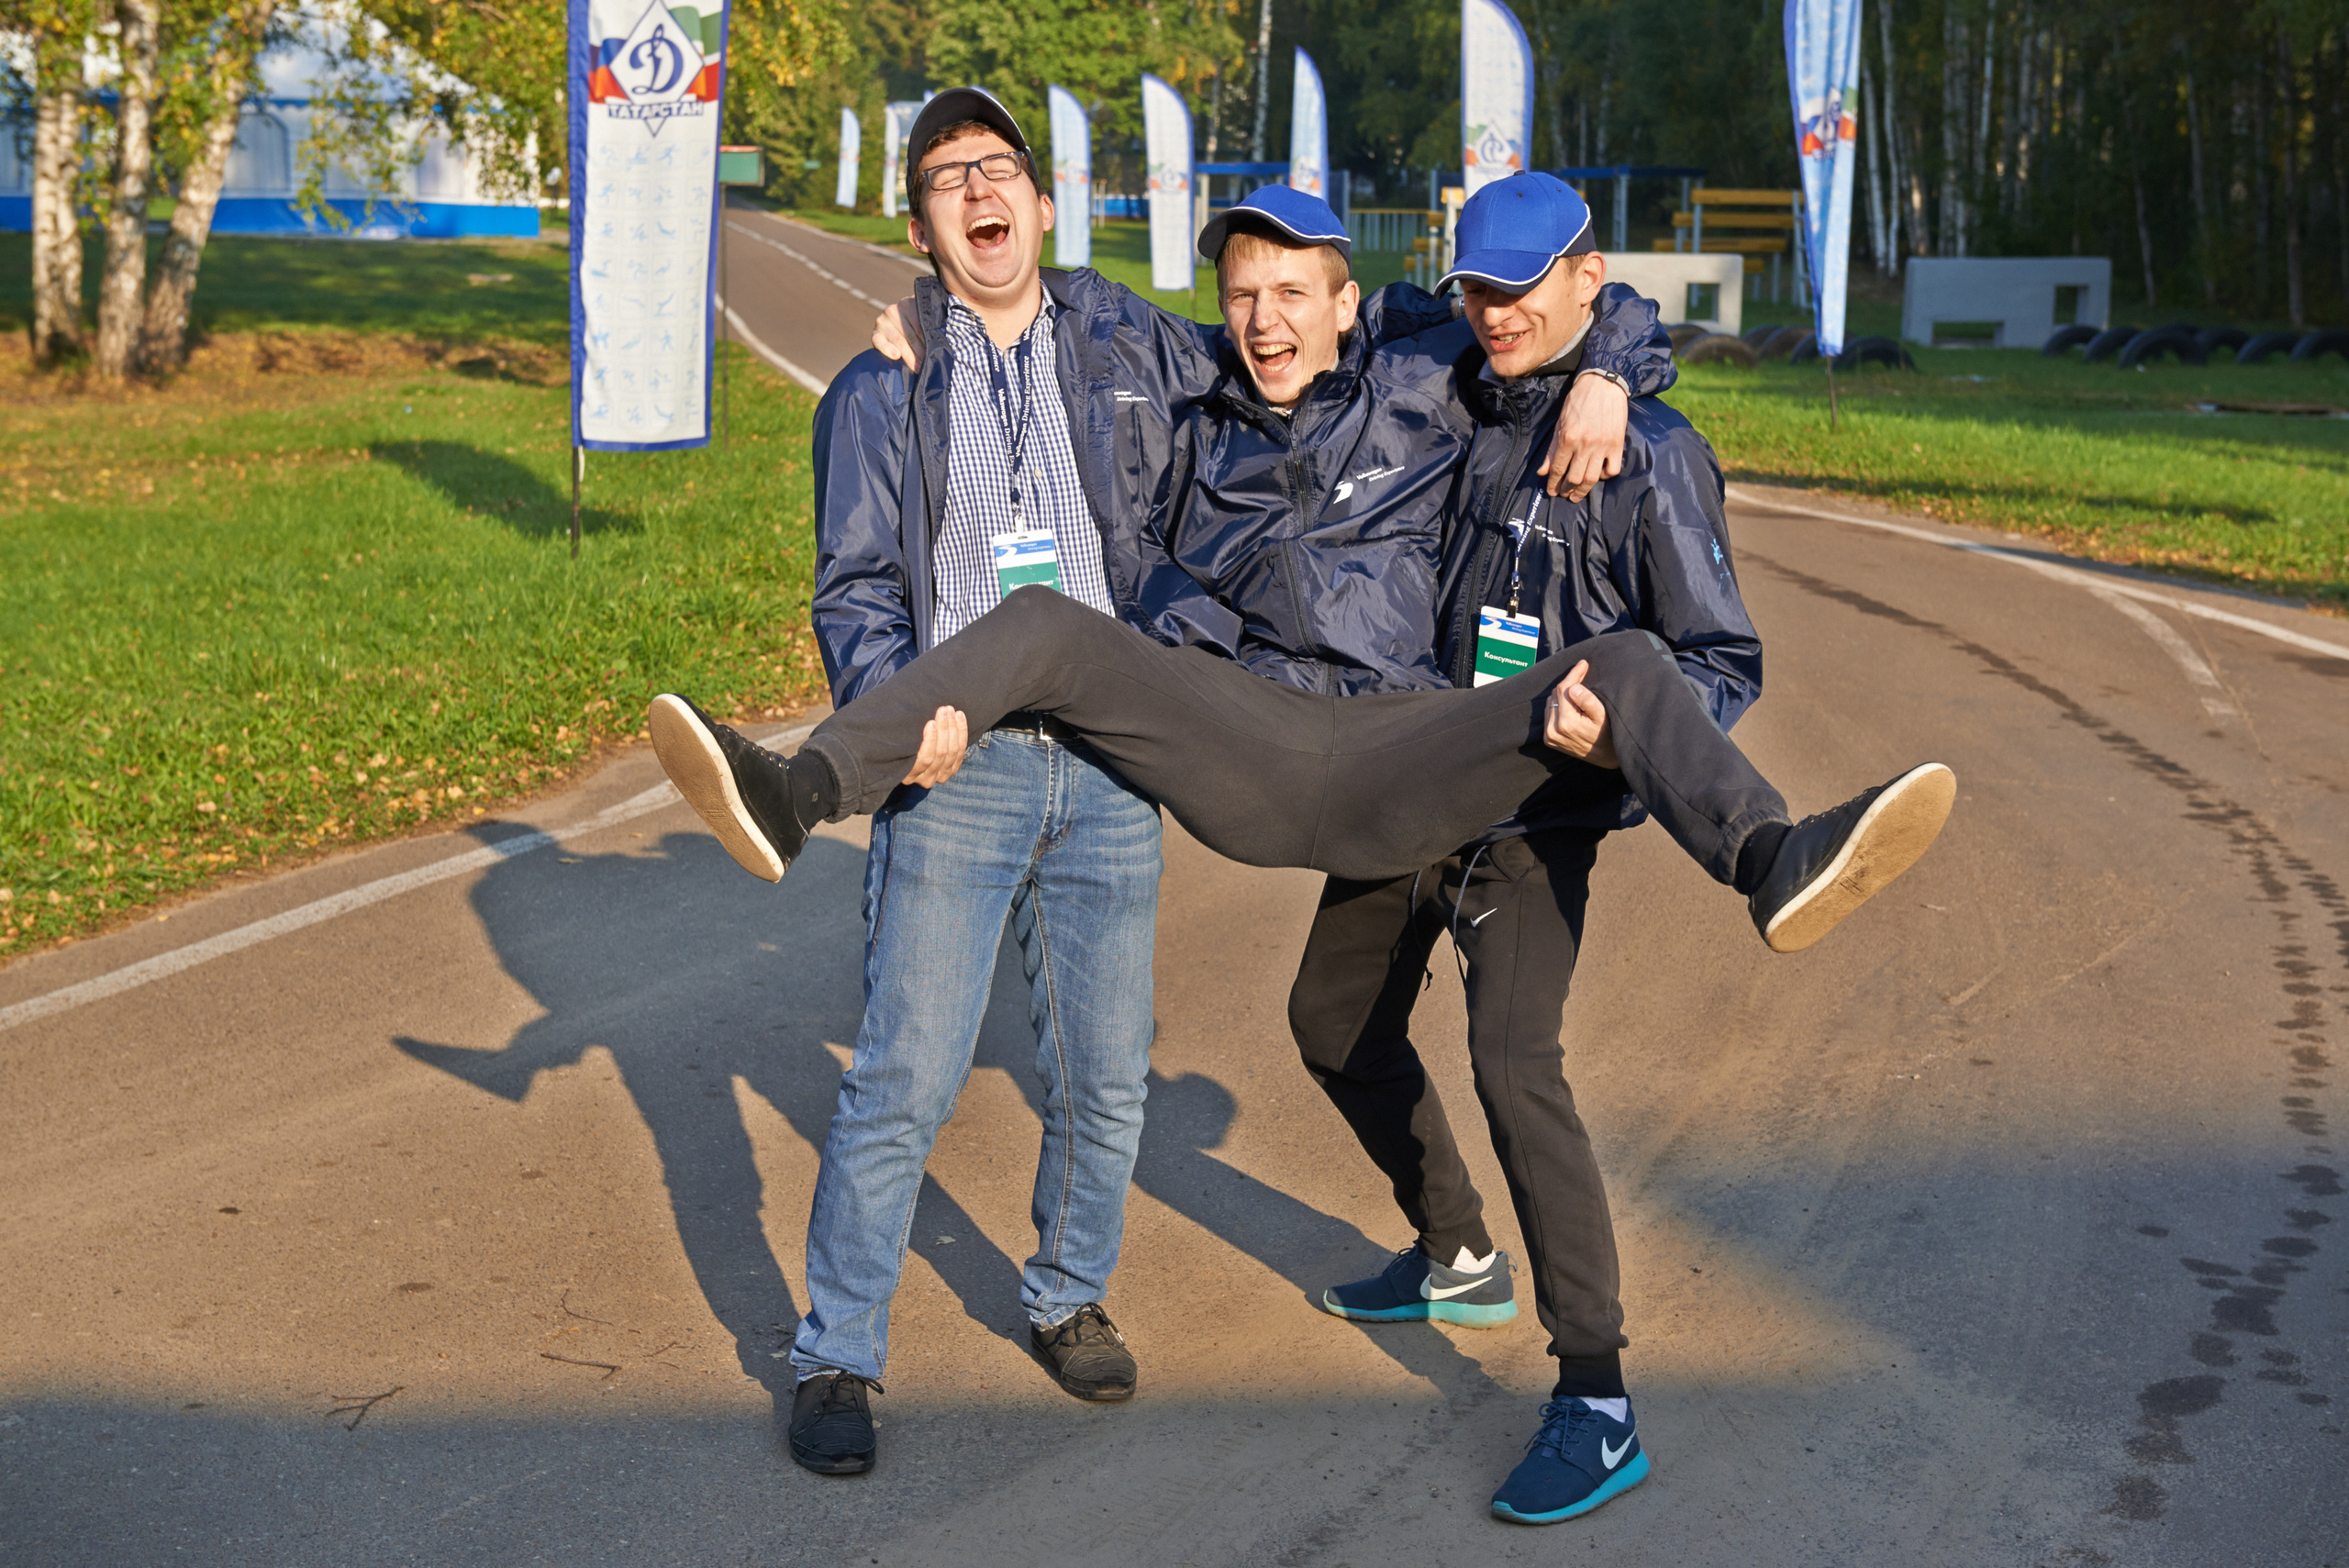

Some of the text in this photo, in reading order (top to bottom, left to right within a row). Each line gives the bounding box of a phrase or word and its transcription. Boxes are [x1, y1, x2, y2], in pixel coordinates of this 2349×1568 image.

[608, 101, 704, 120] ТАТАРСТАН
[1023, 355, 1031, 395] Experience
[1022, 395, 1031, 421] Driving
[997, 388, 1008, 427] Volkswagen
[1005, 428, 1013, 455] Driving
[1485, 651, 1528, 667] Консультант
